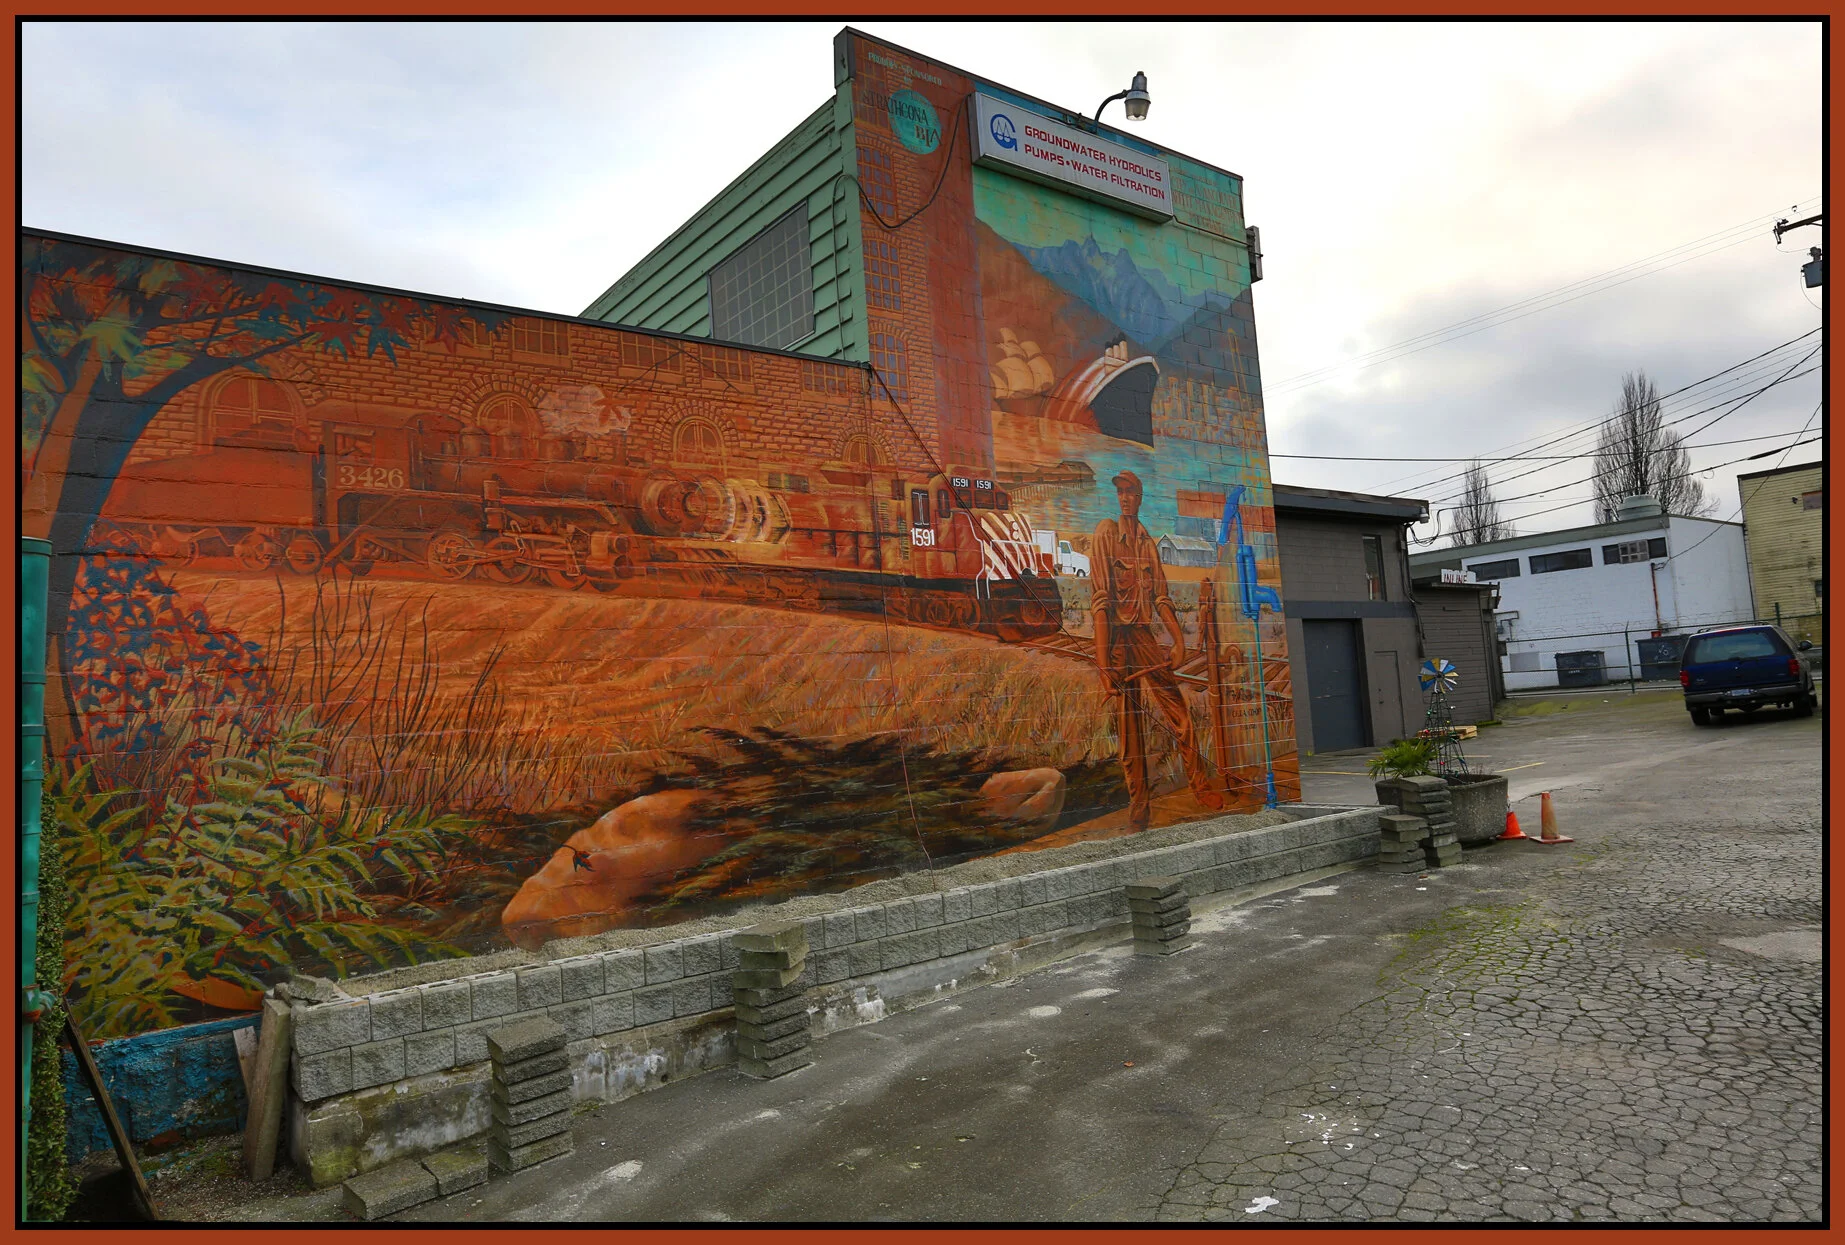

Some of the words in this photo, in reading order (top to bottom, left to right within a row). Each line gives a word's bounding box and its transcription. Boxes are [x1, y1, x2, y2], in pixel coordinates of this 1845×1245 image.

[901, 64, 942, 86] SPONSORED
[862, 90, 929, 126] STRATHCONA
[915, 125, 942, 147] BIA
[1024, 125, 1106, 162] GROUNDWATER
[1109, 157, 1162, 182] HYDROLICS
[1111, 173, 1165, 200] FILTRATION
[340, 465, 404, 489] 3426
[953, 478, 969, 488] 1591
[976, 479, 992, 490] 1591
[911, 528, 935, 546] 1591
